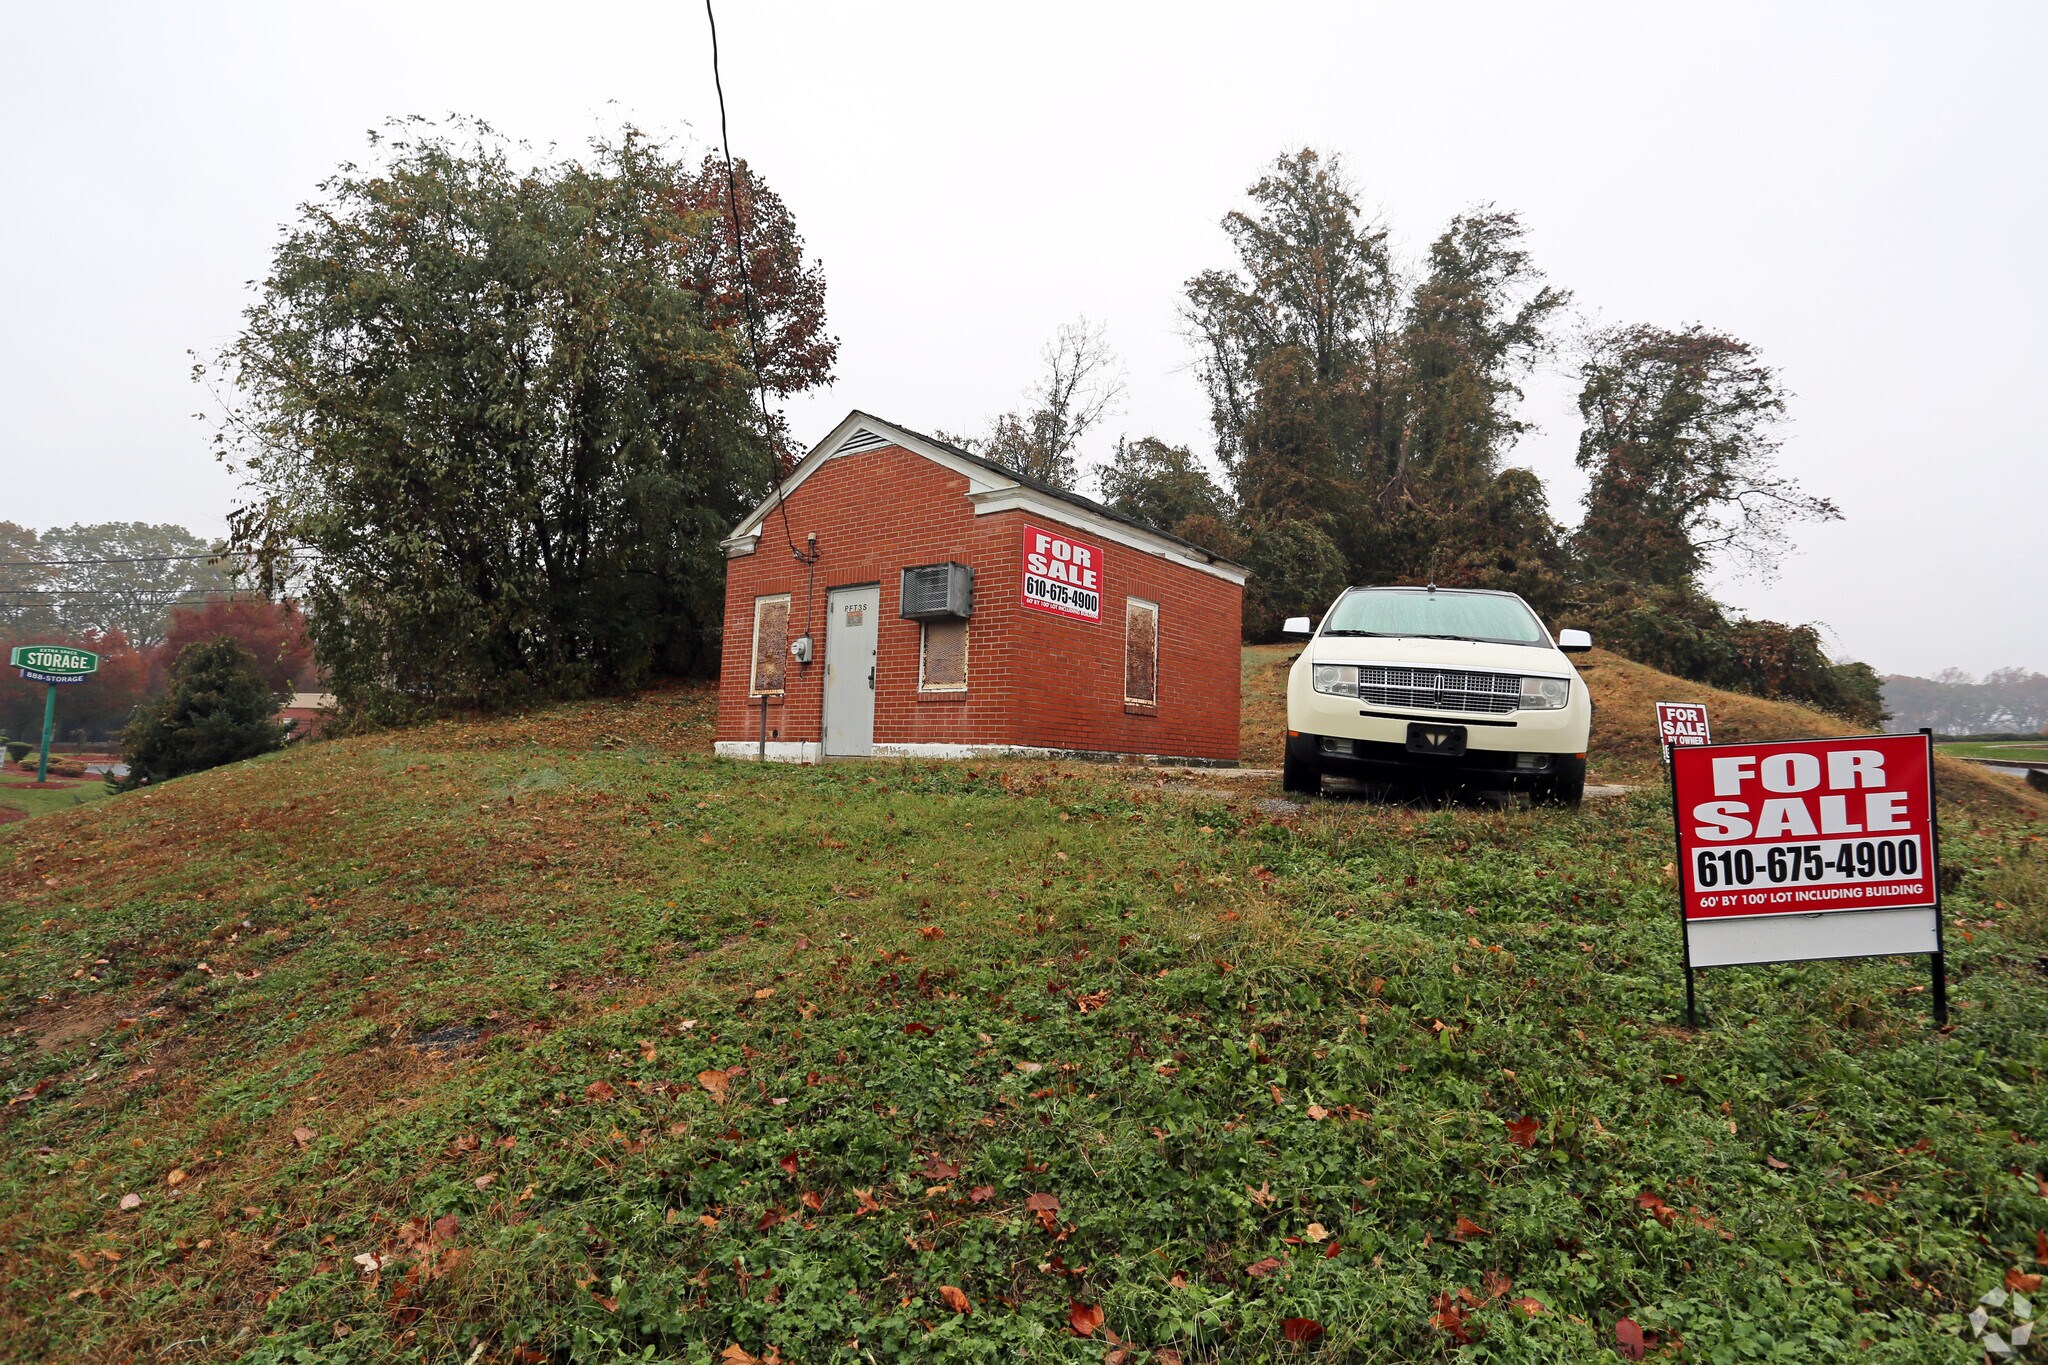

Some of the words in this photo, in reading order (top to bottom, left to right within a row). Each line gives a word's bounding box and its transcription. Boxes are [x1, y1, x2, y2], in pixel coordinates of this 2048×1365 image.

[1036, 533, 1091, 568] FOR
[1027, 553, 1097, 589] SALE
[1026, 576, 1097, 611] 610-675-4900
[27, 652, 88, 669] STORAGE
[26, 671, 84, 682] 888-STORAGE
[1662, 721, 1706, 736] SALE
[1666, 708, 1698, 721] FOR
[1668, 735, 1678, 744] BY
[1679, 736, 1704, 745] OWNER
[1712, 750, 1886, 796] FOR
[1692, 791, 1912, 841] SALE
[1697, 839, 1918, 888] 610-675-4900
[1700, 896, 1718, 908] 60'
[1722, 895, 1738, 907] BY
[1741, 893, 1768, 905] 100'
[1770, 891, 1793, 903] LOT
[1795, 886, 1863, 902] INCLUDING
[1865, 884, 1924, 898] BUILDING
